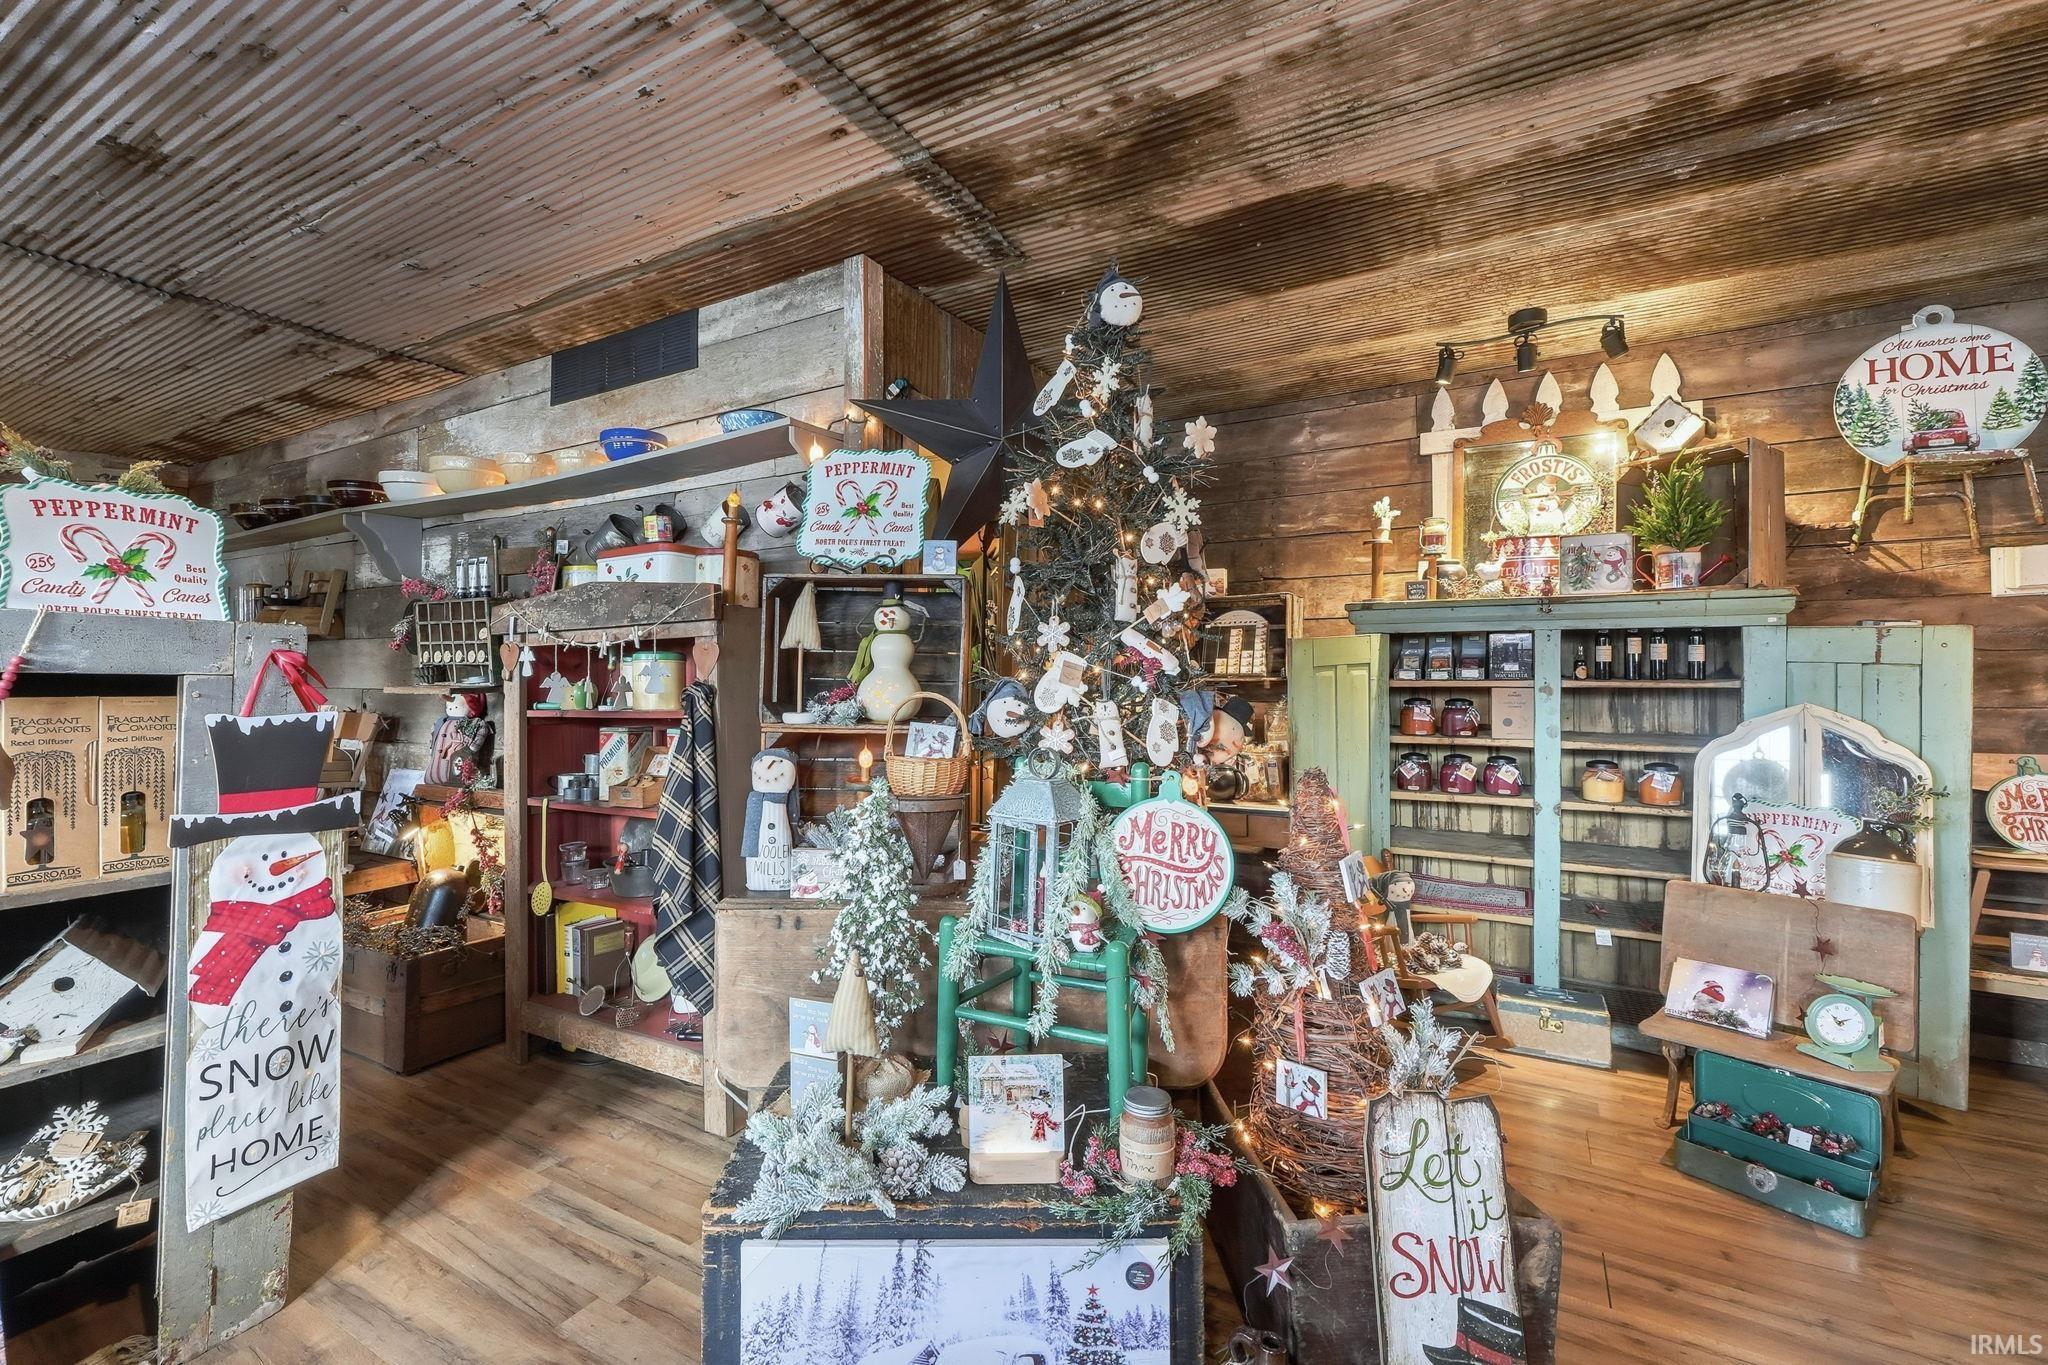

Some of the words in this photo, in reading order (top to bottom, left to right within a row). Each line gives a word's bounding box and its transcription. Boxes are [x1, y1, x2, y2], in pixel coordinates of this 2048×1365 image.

[1882, 338, 1913, 354] All
[1913, 336, 1958, 349] hearts
[1958, 333, 1992, 344] come
[1863, 342, 2014, 385] HOME
[1882, 386, 1899, 397] for
[1901, 379, 1990, 398] Christmas
[825, 461, 915, 479] PEPPERMINT
[30, 499, 199, 534] PEPPERMINT
[893, 511, 914, 519] Quality
[810, 521, 842, 534] Candy
[883, 522, 913, 533] Canes
[860, 539, 881, 547] FINEST
[186, 564, 206, 574] Best
[174, 574, 208, 585] Quality
[21, 577, 86, 598] Candy
[162, 588, 212, 604] Canes
[9, 717, 82, 728] FRAGRANT
[107, 715, 170, 725] FRAGRANT
[22, 725, 92, 736] COMFORTS
[107, 735, 129, 743] Reed
[11, 739, 35, 747] Reed
[38, 738, 74, 746] Diffuser
[600, 737, 626, 770] PREMIUM
[102, 856, 170, 872] CROSSROADS
[754, 860, 786, 876] MILLS
[6, 867, 81, 884] CROSSROADS
[207, 996, 337, 1051] there's
[199, 1029, 335, 1102] SNOW
[196, 1104, 277, 1152] place
[287, 1072, 337, 1114] like
[210, 1114, 325, 1181] HOME
[1379, 1118, 1482, 1203] Let
[1464, 1189, 1507, 1235] it
[1389, 1231, 1507, 1299] SNOW
